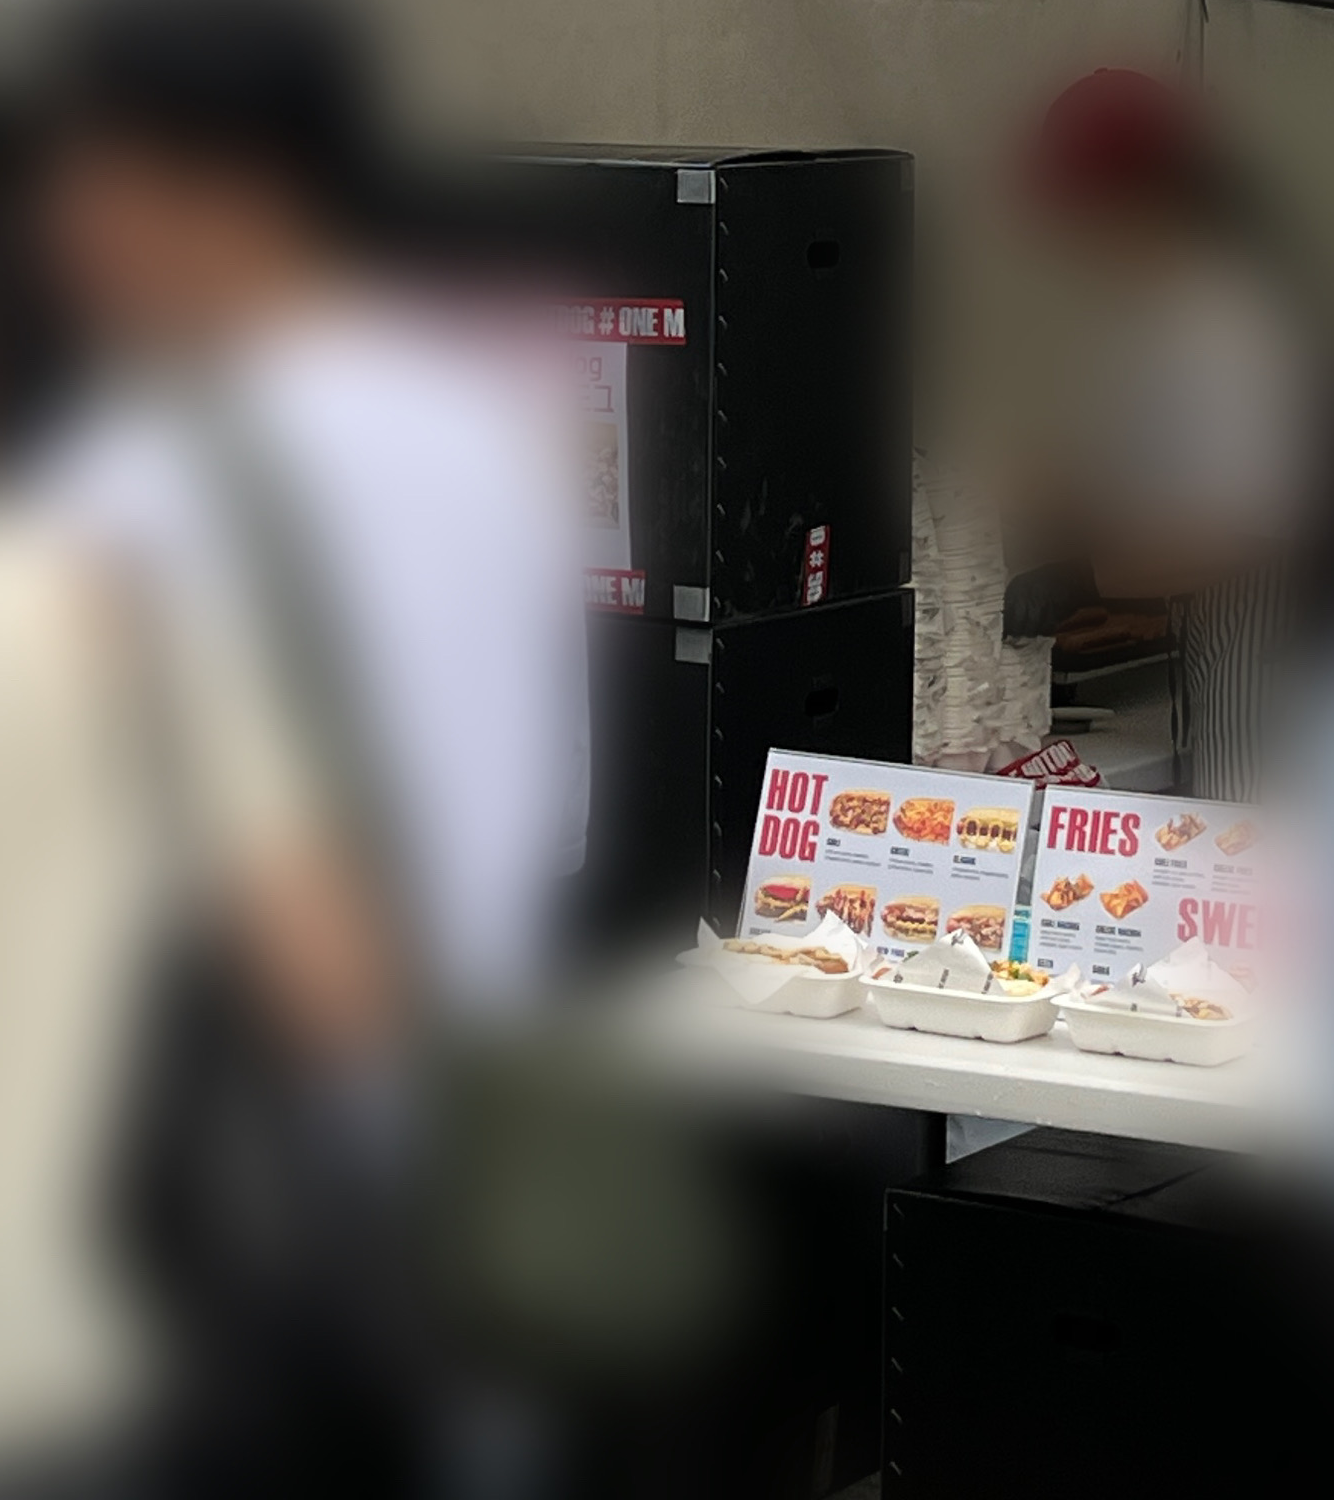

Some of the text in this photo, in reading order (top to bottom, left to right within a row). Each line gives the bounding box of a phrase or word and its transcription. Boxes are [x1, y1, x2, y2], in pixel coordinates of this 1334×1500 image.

[619, 307, 659, 336] ONE
[766, 768, 829, 816] HOT
[758, 814, 820, 863] DOG
[1047, 806, 1142, 858] FRIES
